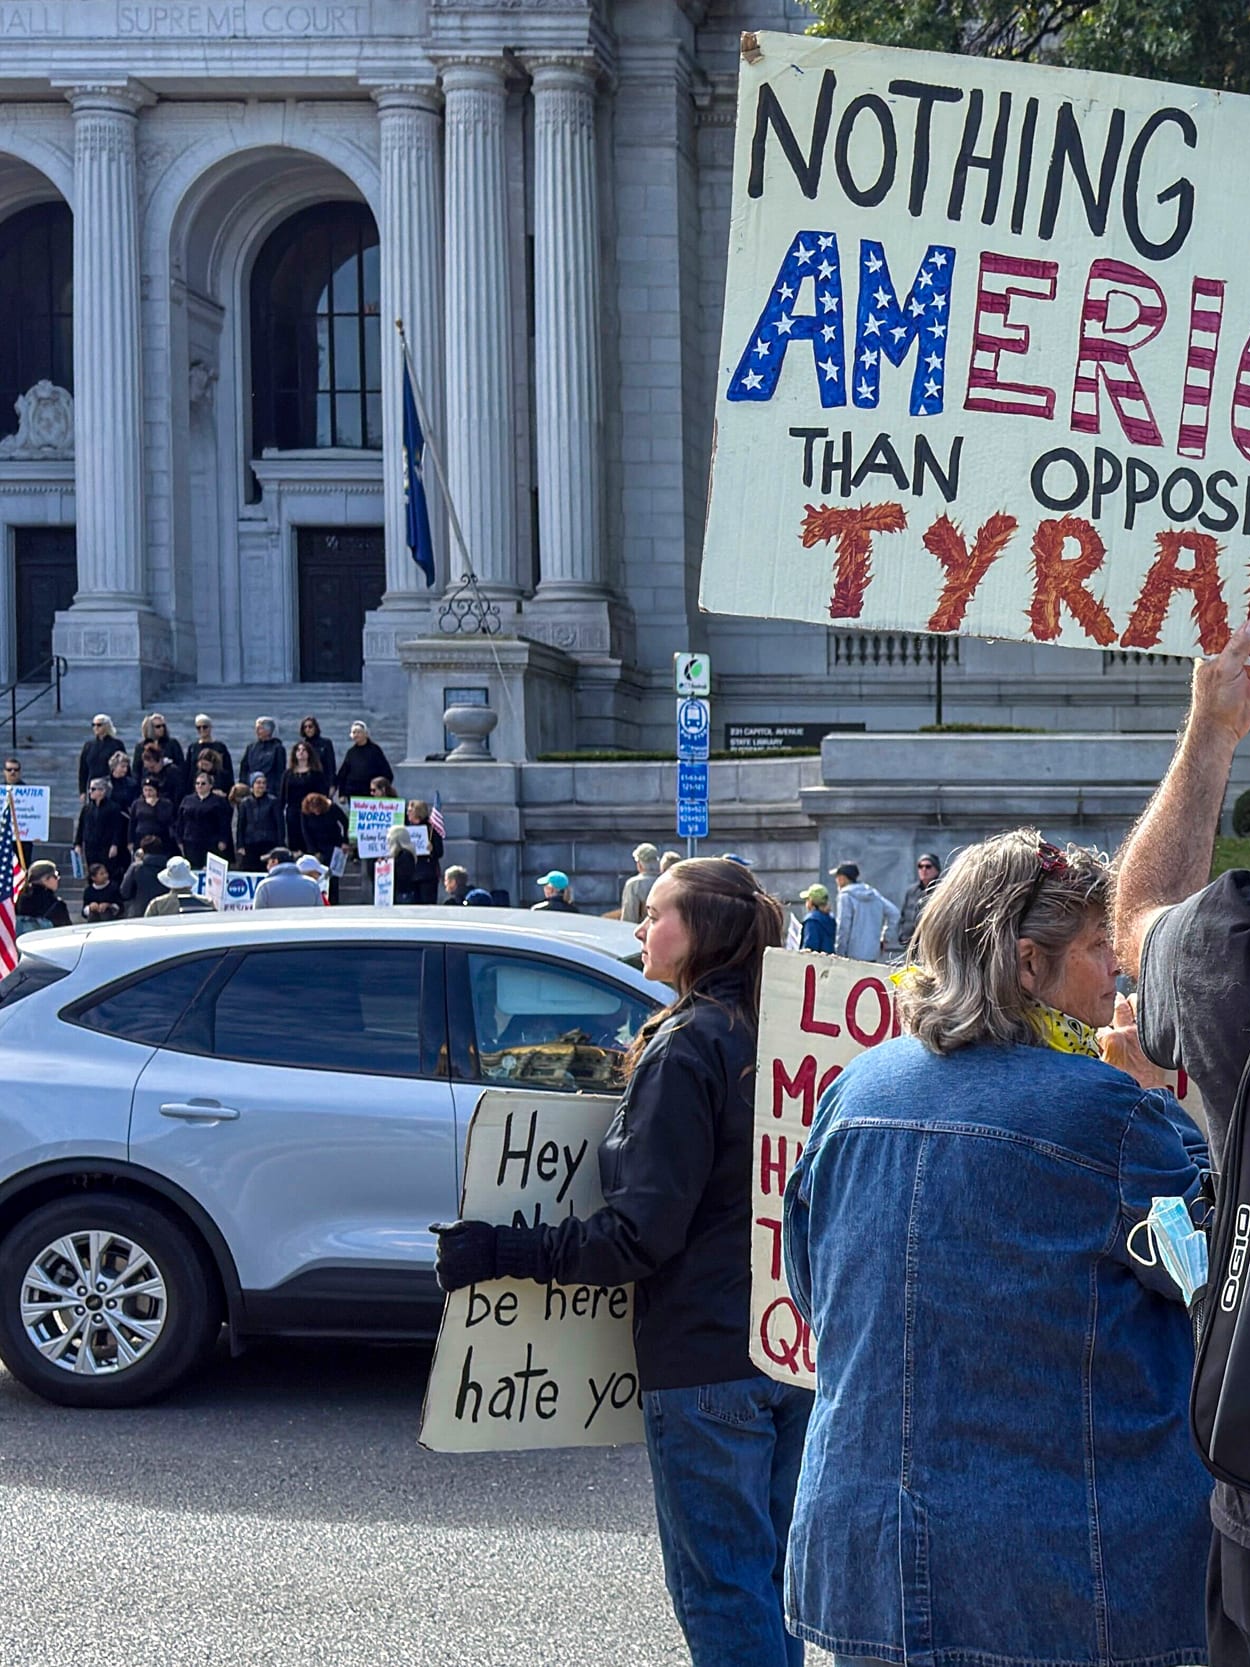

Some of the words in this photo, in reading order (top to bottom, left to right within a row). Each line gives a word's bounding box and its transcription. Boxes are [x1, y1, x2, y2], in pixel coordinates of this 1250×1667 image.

[120, 6, 247, 34] SUPREME
[262, 6, 364, 34] COURT
[748, 69, 1198, 261] NOTHING
[788, 427, 964, 502] THAN
[730, 738, 751, 746] STATE
[752, 738, 783, 746] LIBRARY
[743, 727, 773, 736] CAPITOL
[775, 727, 804, 736] AVENUE
[358, 810, 391, 822] WORDS
[800, 965, 902, 1048] LO
[497, 1110, 588, 1203] Hey
[465, 1283, 518, 1328] be
[545, 1280, 628, 1321] here
[455, 1343, 558, 1423] hate
